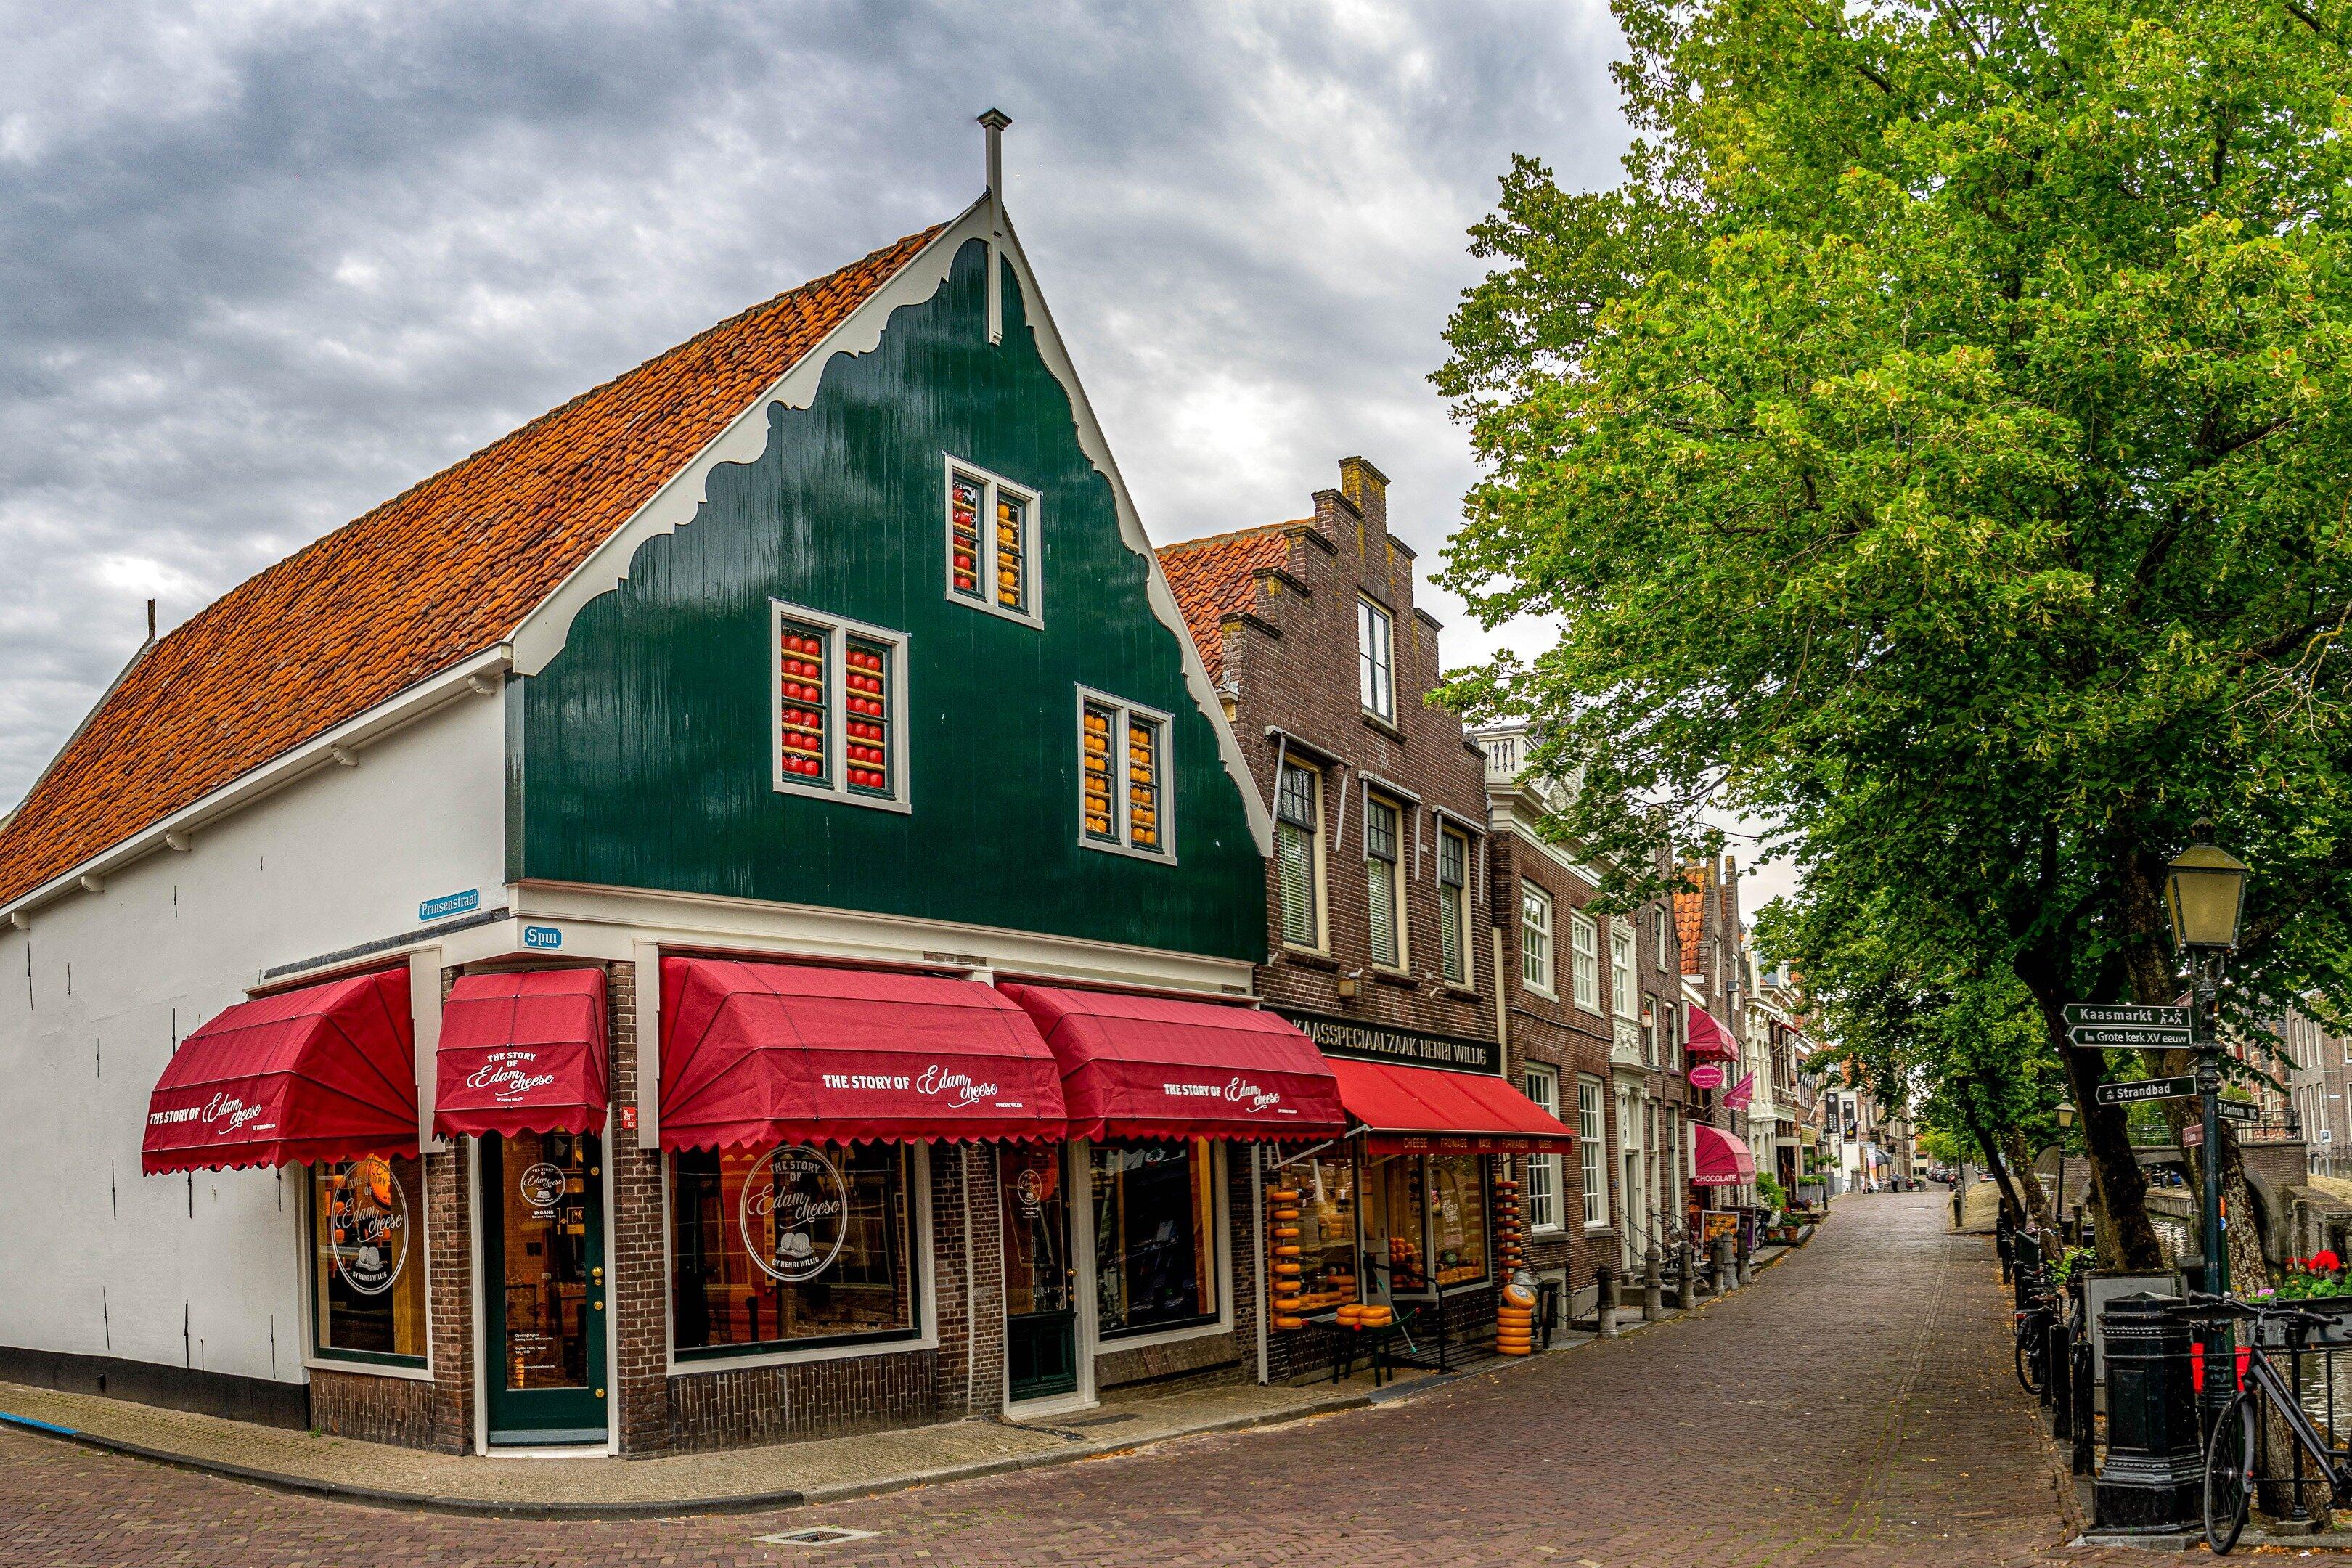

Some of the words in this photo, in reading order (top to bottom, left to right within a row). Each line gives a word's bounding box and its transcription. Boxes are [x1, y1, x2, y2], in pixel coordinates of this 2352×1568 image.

[421, 892, 478, 917] Prinsenstraat
[528, 928, 557, 945] Spui
[2080, 1008, 2152, 1021] Kaasmarkt
[2097, 1032, 2123, 1042] Grote
[2126, 1032, 2145, 1042] kerk
[2147, 1033, 2160, 1042] XV
[2163, 1035, 2186, 1044] eeuw
[487, 1053, 505, 1063] THE
[507, 1051, 537, 1061] STORY
[1420, 1040, 1450, 1061] HENRI
[1453, 1044, 1487, 1066] WILLIG
[467, 1064, 521, 1088] Edam
[502, 1072, 555, 1094] cheese
[822, 1074, 849, 1089] THE
[852, 1075, 891, 1090] STORY
[894, 1076, 910, 1090] OF
[916, 1064, 968, 1095] Edam
[954, 1077, 998, 1105] cheese
[1163, 1083, 1181, 1095] THE
[1182, 1085, 1210, 1097] STORY
[1210, 1086, 1221, 1097] OF
[1225, 1077, 1259, 1102] Edam
[1250, 1089, 1280, 1110] cheese
[2117, 1082, 2171, 1098] Strandbad
[150, 1112, 164, 1125] THE
[164, 1109, 189, 1124] STORY
[189, 1107, 200, 1120] OF
[202, 1092, 241, 1122] Edam
[224, 1101, 262, 1130] cheese
[2224, 1103, 2245, 1116] Centrum
[1404, 1138, 1428, 1148] CHEESE
[768, 1161, 788, 1174] THE
[790, 1161, 821, 1174] STORY
[790, 1172, 802, 1182] OF
[349, 1177, 363, 1189] THE
[364, 1176, 387, 1186] SORY
[747, 1183, 808, 1216] Edam
[336, 1197, 377, 1229] Edam
[787, 1196, 840, 1226] cheese
[363, 1209, 404, 1239] cheese
[772, 1258, 780, 1267] BY
[799, 1256, 820, 1267] WILLIG
[372, 1271, 387, 1281] WILLIG
